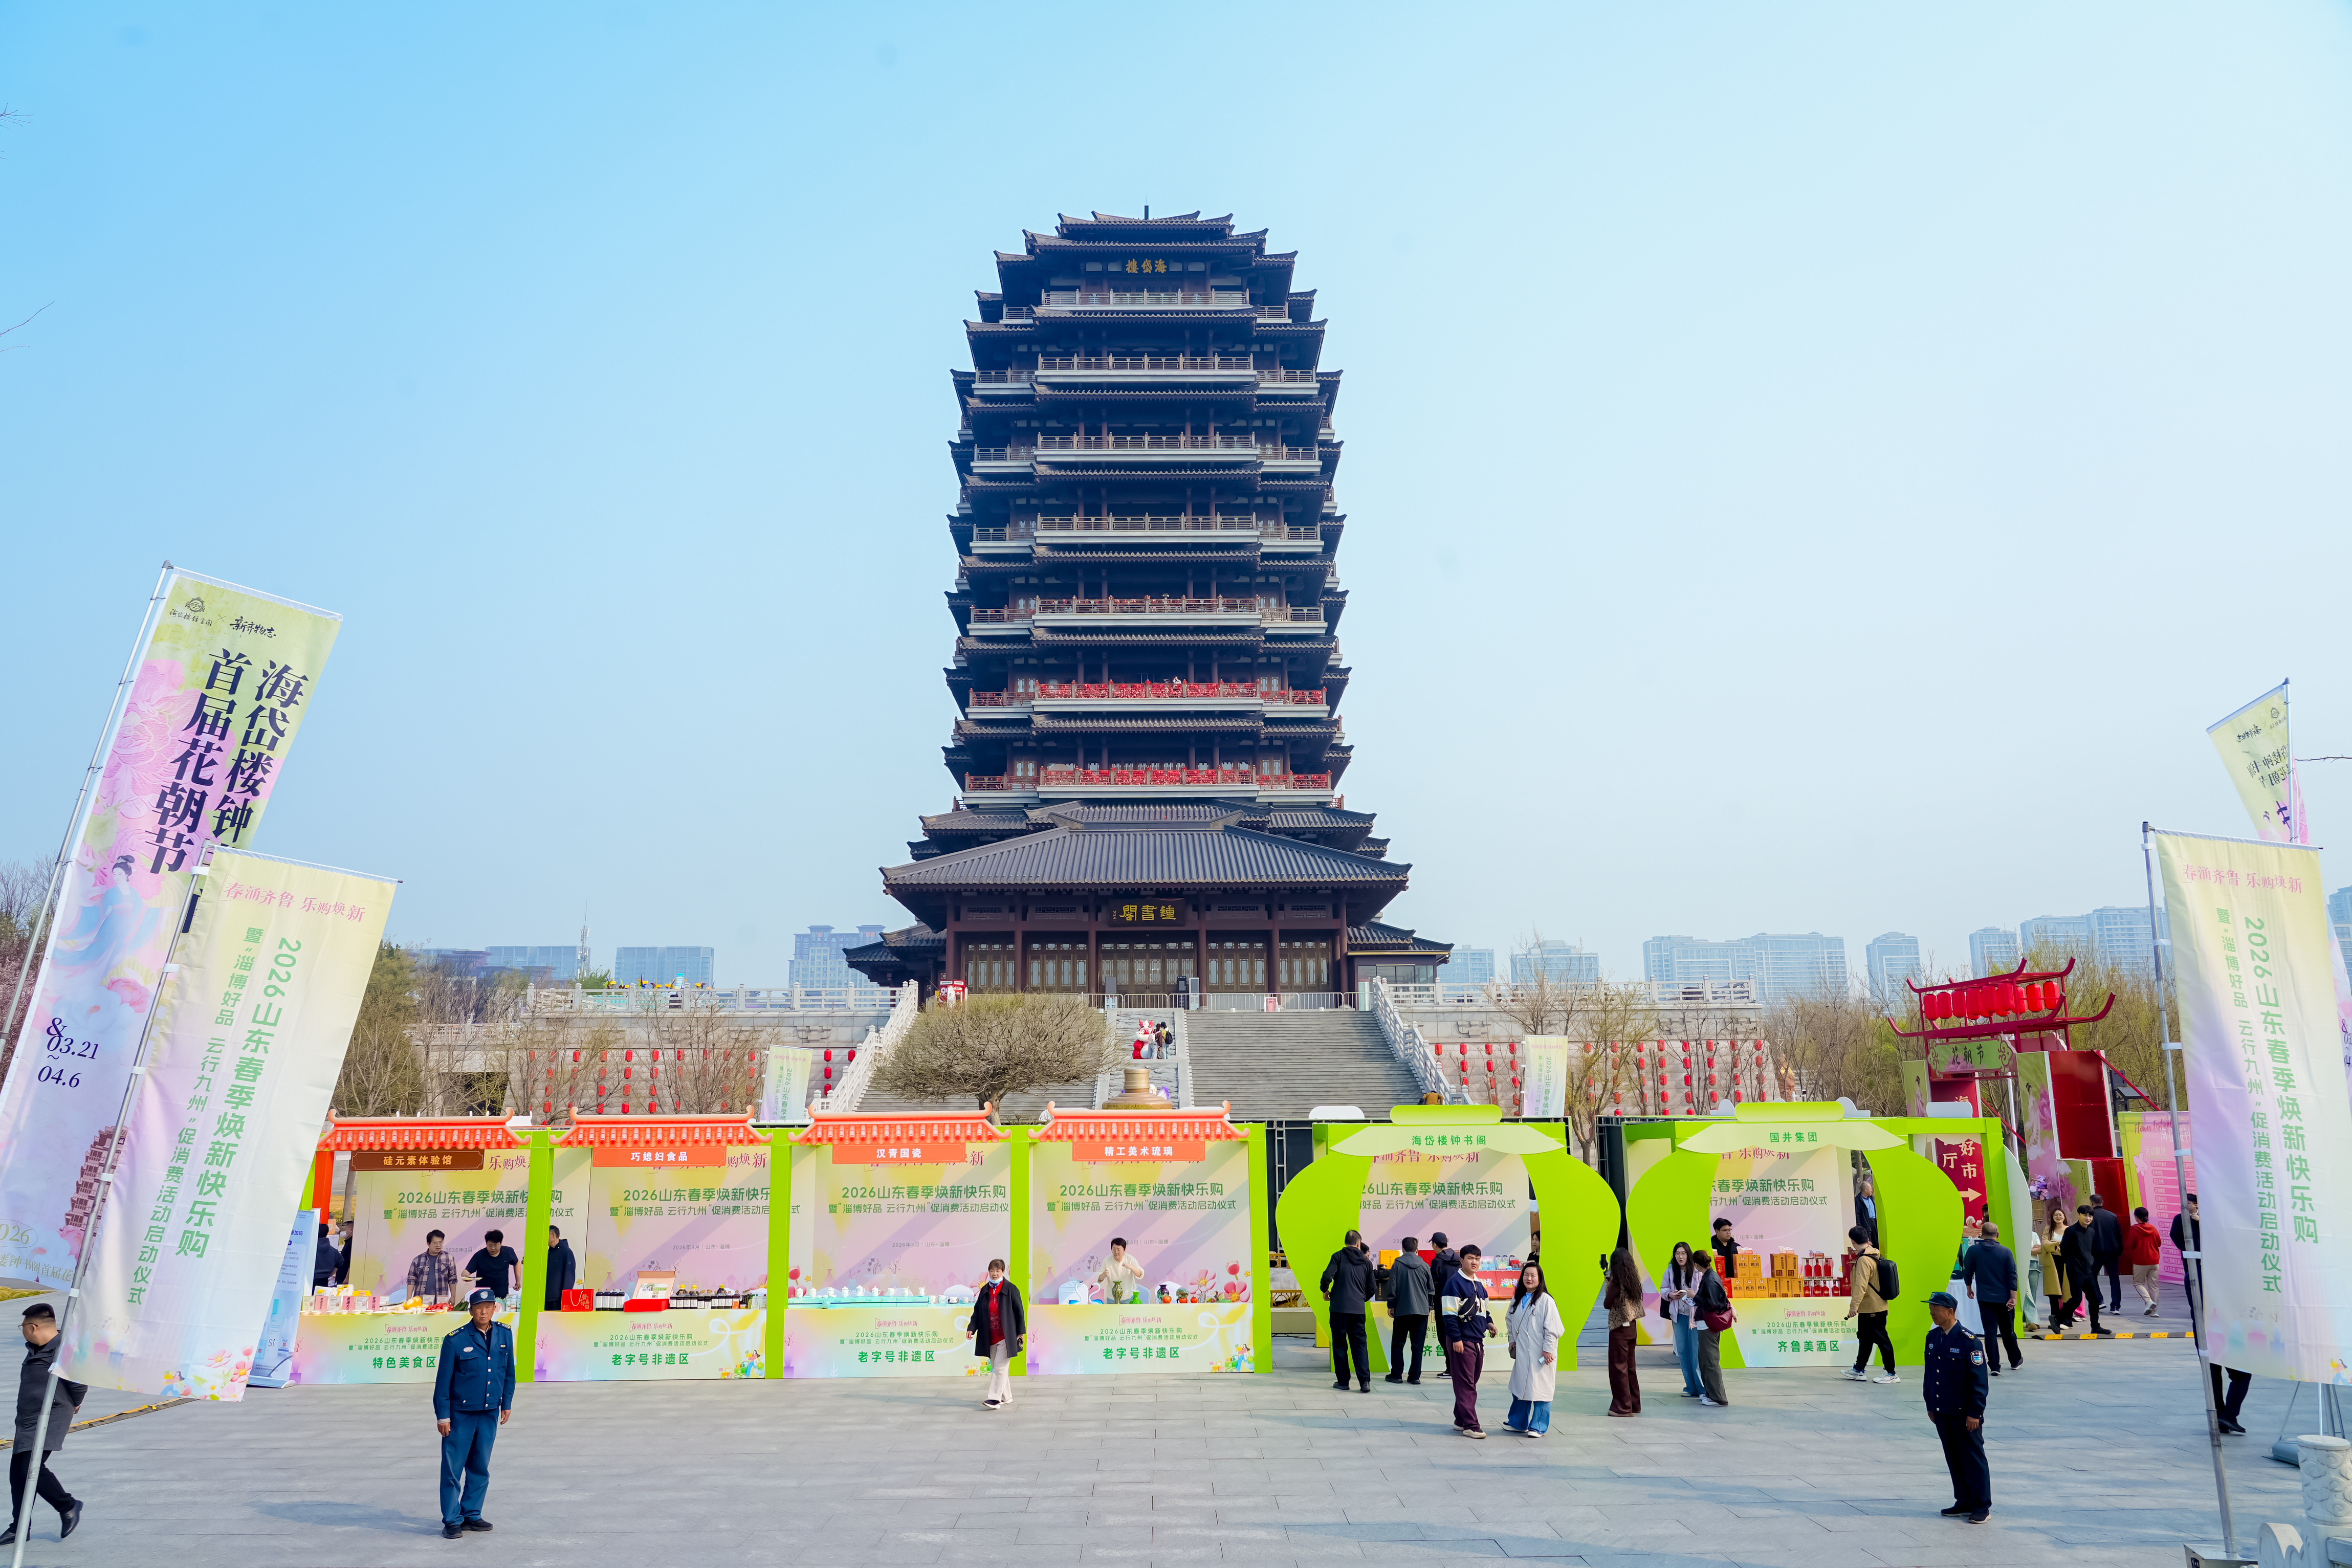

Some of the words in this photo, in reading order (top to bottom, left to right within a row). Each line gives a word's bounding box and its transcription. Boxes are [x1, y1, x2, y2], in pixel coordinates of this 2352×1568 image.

[145, 648, 253, 874] 首届花朝节
[2182, 864, 2240, 887] 春涌齐鲁
[2246, 872, 2303, 895] 乐购焕新
[223, 882, 295, 908] 春涌齐鲁
[299, 896, 366, 922] 乐购焕新
[1952, 1043, 1984, 1065] 花朝节
[37, 1065, 83, 1088] 04.6
[2244, 917, 2319, 1245] 2026山东春季焕新快乐购
[175, 937, 302, 1258] 2026山东春季焕新快乐购
[1412, 1135, 1486, 1145] 海岱楼钟书阁
[1770, 1132, 1817, 1142] 国井集团
[630, 1151, 688, 1162] 巧媳妇食品
[876, 1148, 921, 1158] 汉青国瓷
[1104, 1146, 1173, 1157] 精工美术琉璃
[383, 1154, 452, 1166] 硅元素体验馆
[842, 1185, 1006, 1199] 2026山东春季焕新快乐购
[1060, 1183, 1223, 1197] 2026山东春季焕新快乐购
[1777, 1340, 1840, 1352] 齐鲁美酒区
[612, 1353, 689, 1365] 老字号非遗区
[858, 1351, 935, 1362] 老字号非遗区
[1103, 1347, 1180, 1359] 老字号非遗区
[372, 1356, 436, 1369] 特色美食区
